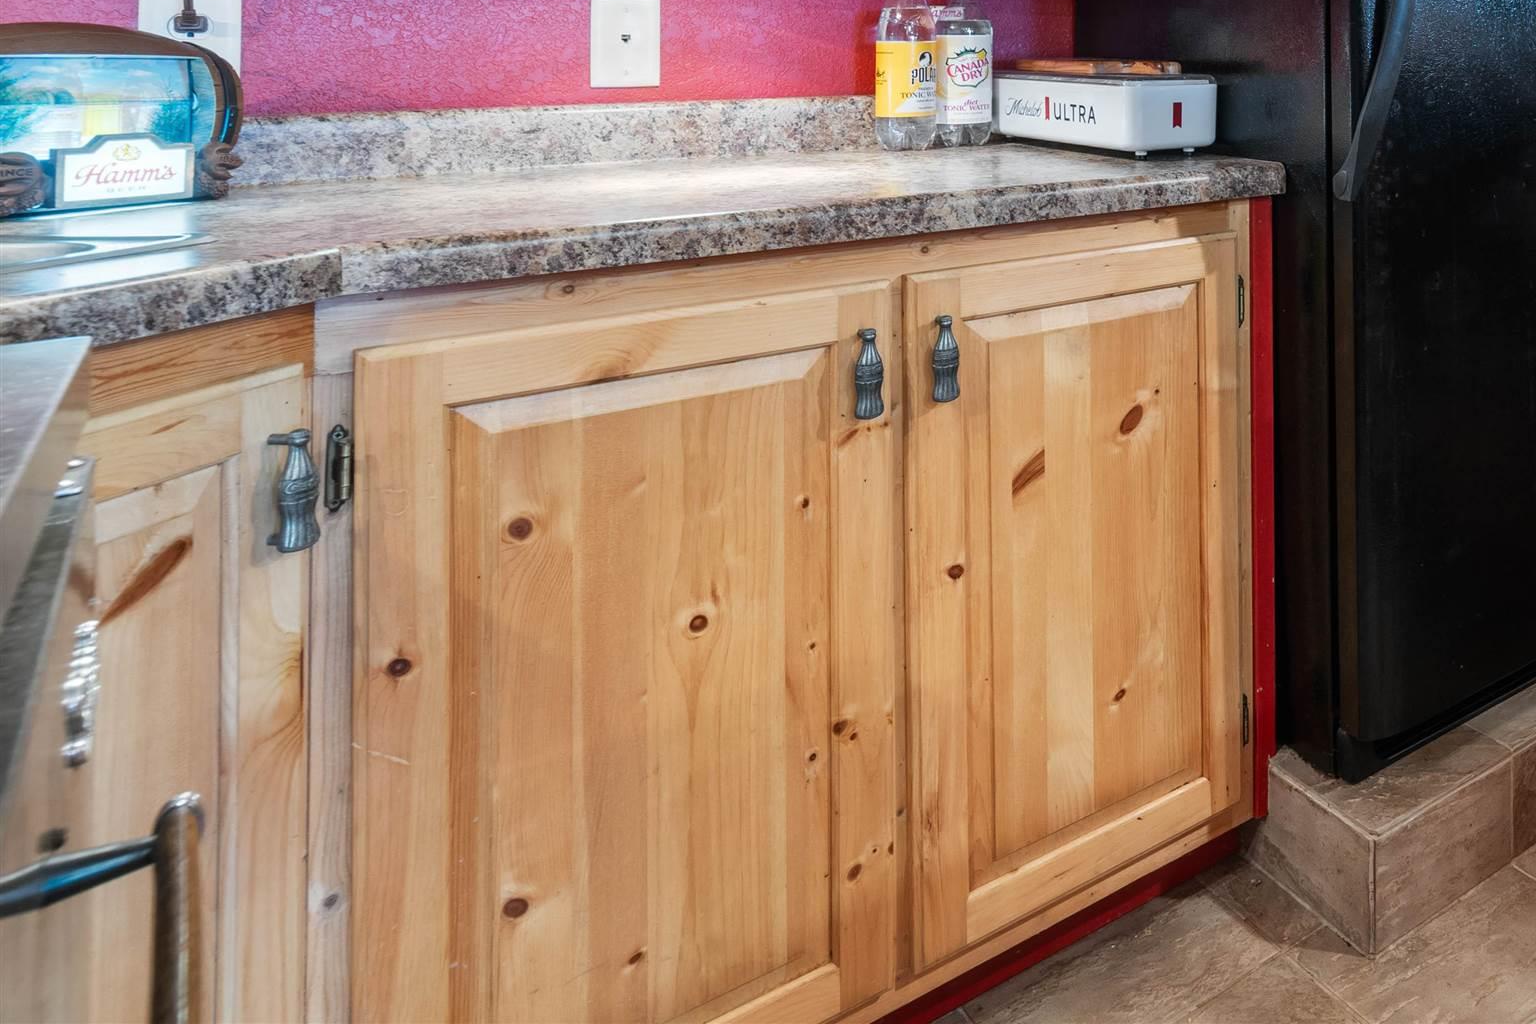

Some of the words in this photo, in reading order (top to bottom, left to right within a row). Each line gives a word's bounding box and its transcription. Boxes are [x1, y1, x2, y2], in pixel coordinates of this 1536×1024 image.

[947, 58, 989, 78] CANADA
[961, 69, 984, 82] DRY
[944, 104, 967, 112] TONIC
[1053, 102, 1097, 125] ULTRA
[71, 163, 177, 188] Hamm's
